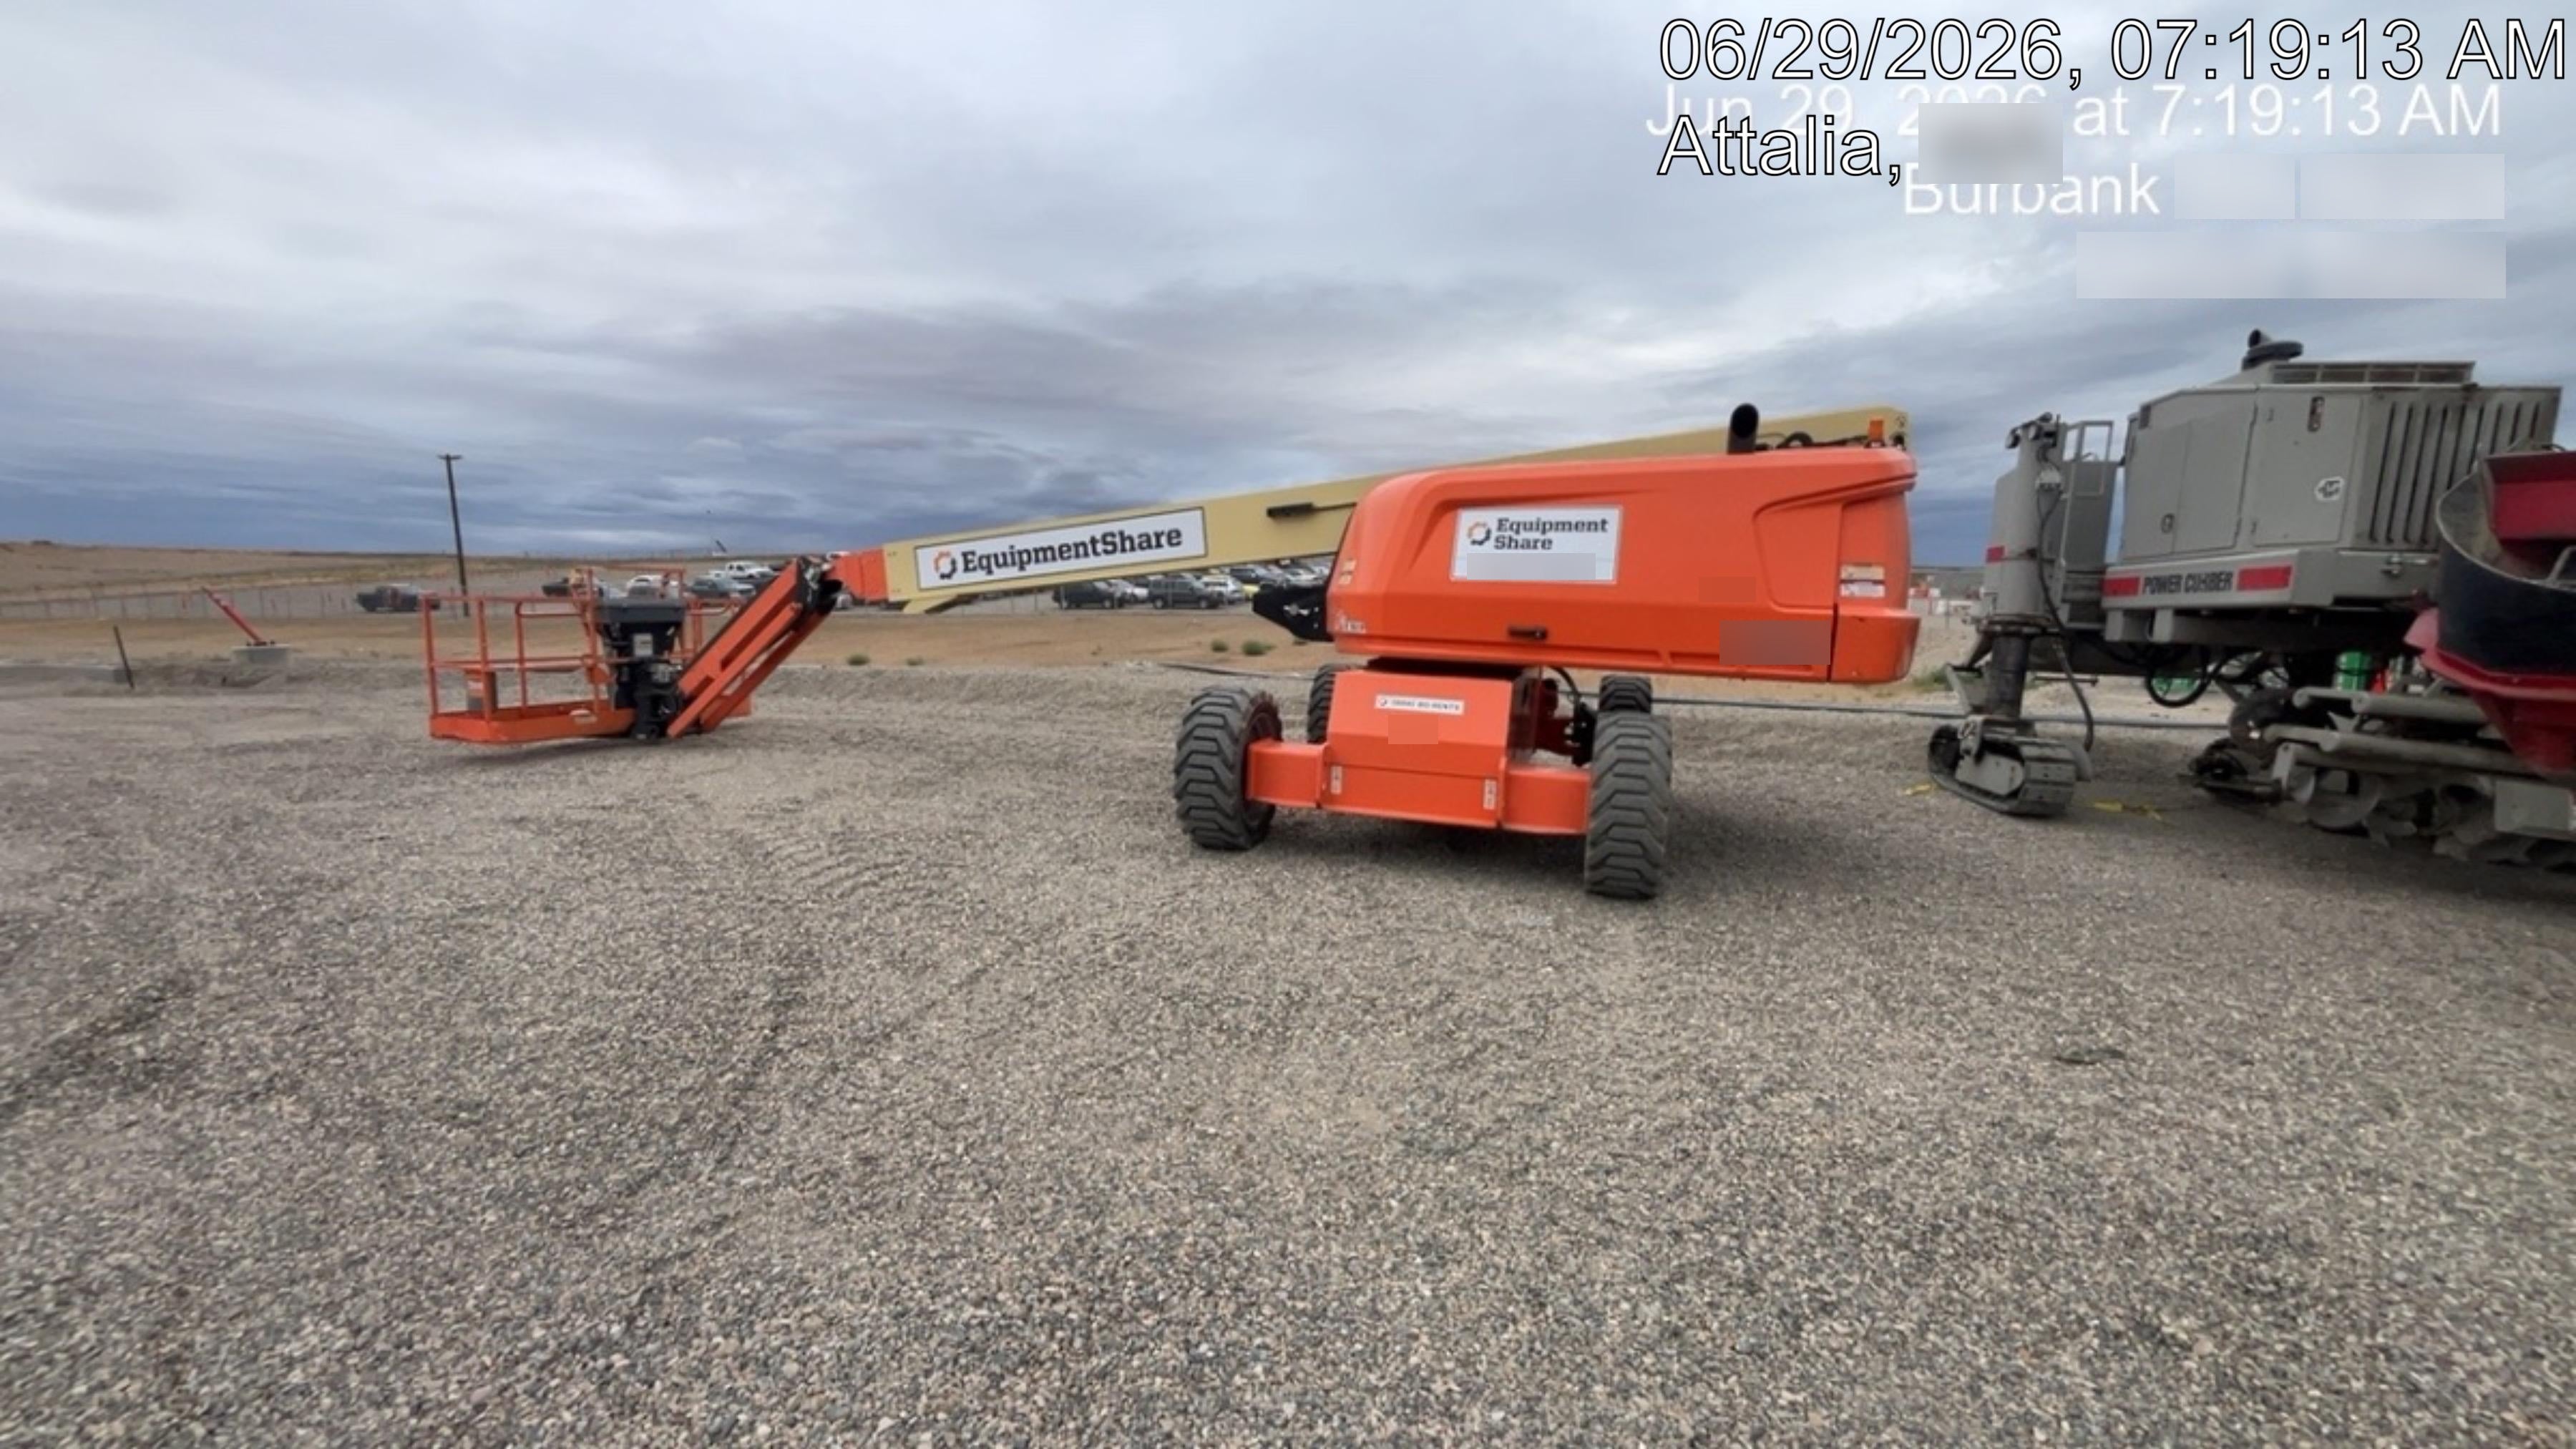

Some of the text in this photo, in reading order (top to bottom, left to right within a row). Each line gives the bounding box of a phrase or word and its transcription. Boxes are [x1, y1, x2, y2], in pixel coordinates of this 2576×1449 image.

[1497, 517, 1609, 535] Equipment
[962, 528, 1182, 575] EquipmentShare
[1494, 535, 1553, 550] Share
